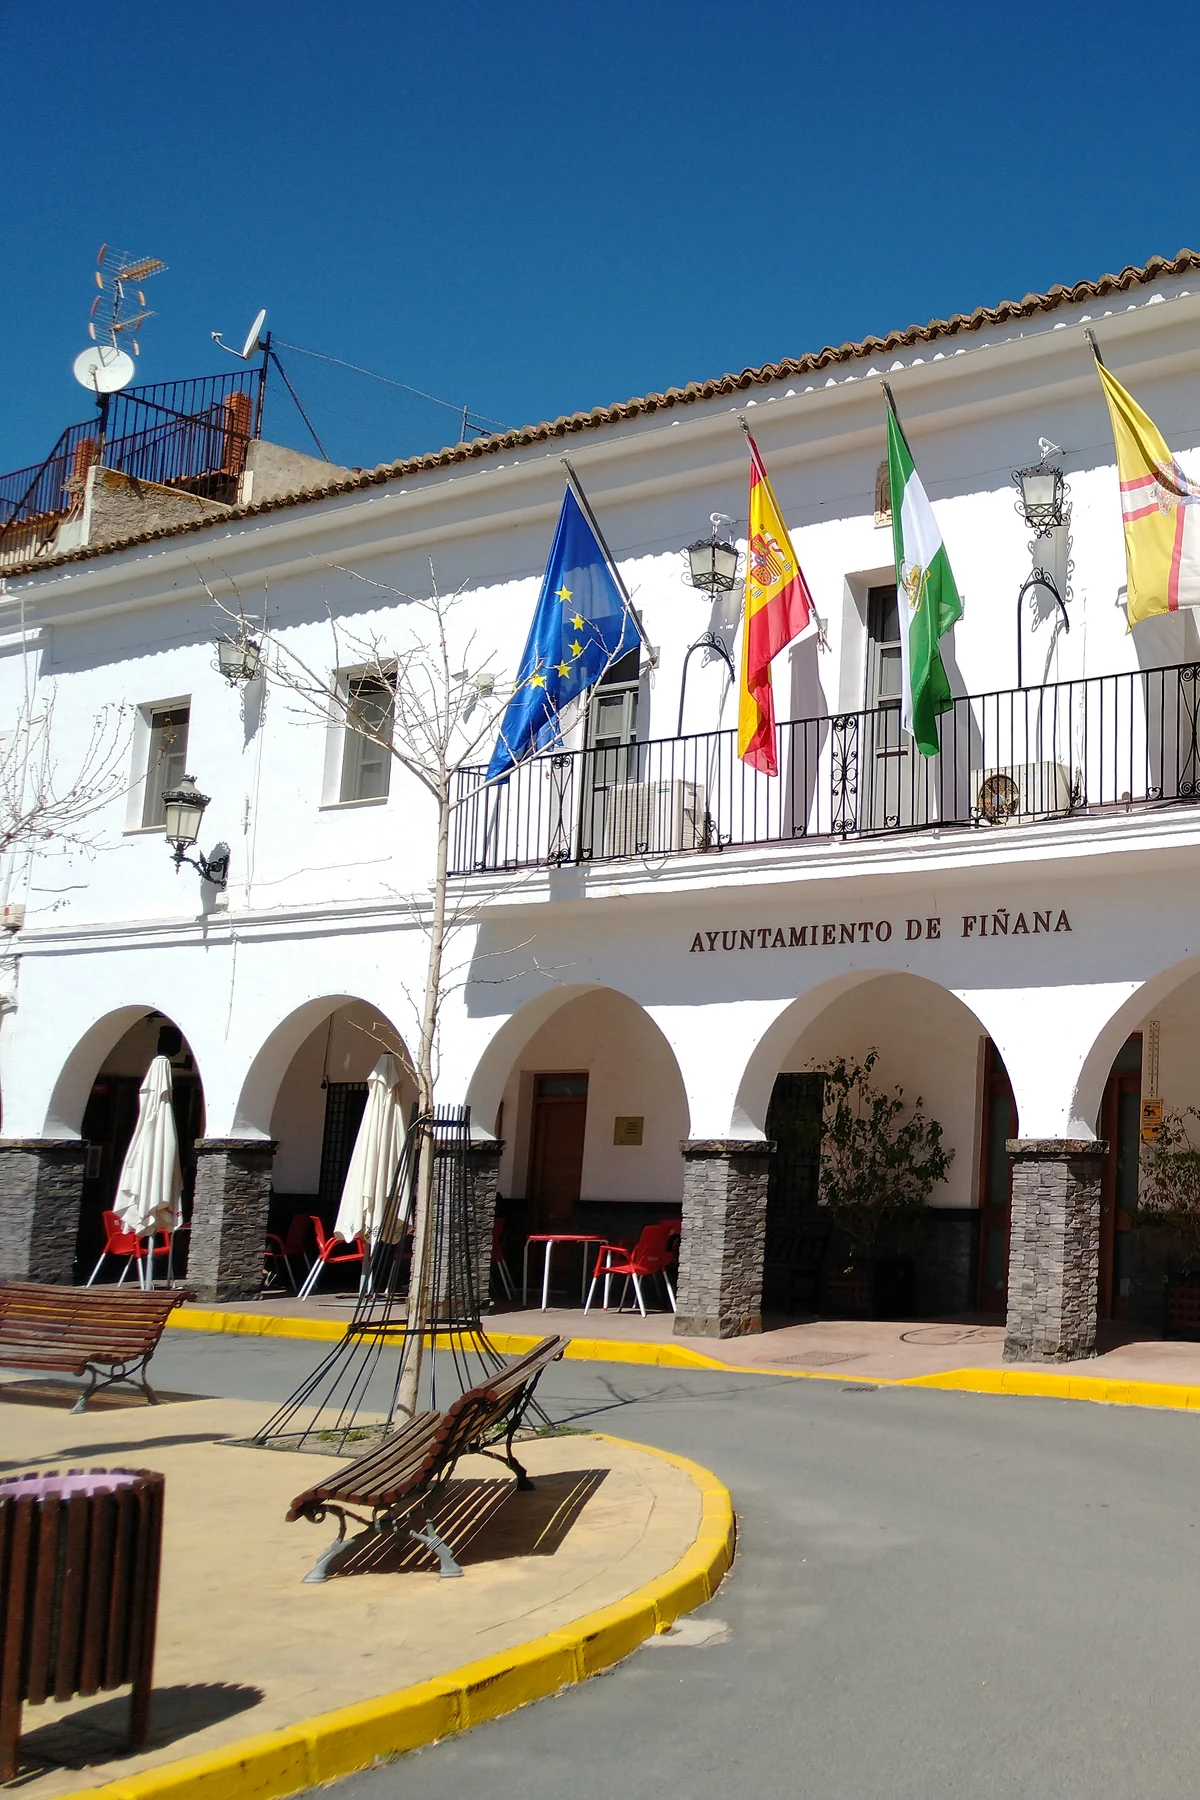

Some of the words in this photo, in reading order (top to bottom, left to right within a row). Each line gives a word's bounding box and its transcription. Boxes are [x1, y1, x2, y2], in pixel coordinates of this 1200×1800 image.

[689, 920, 892, 952] AYUNTAMIENTO
[904, 917, 941, 941] DE
[960, 908, 1073, 938] FIÑANA
